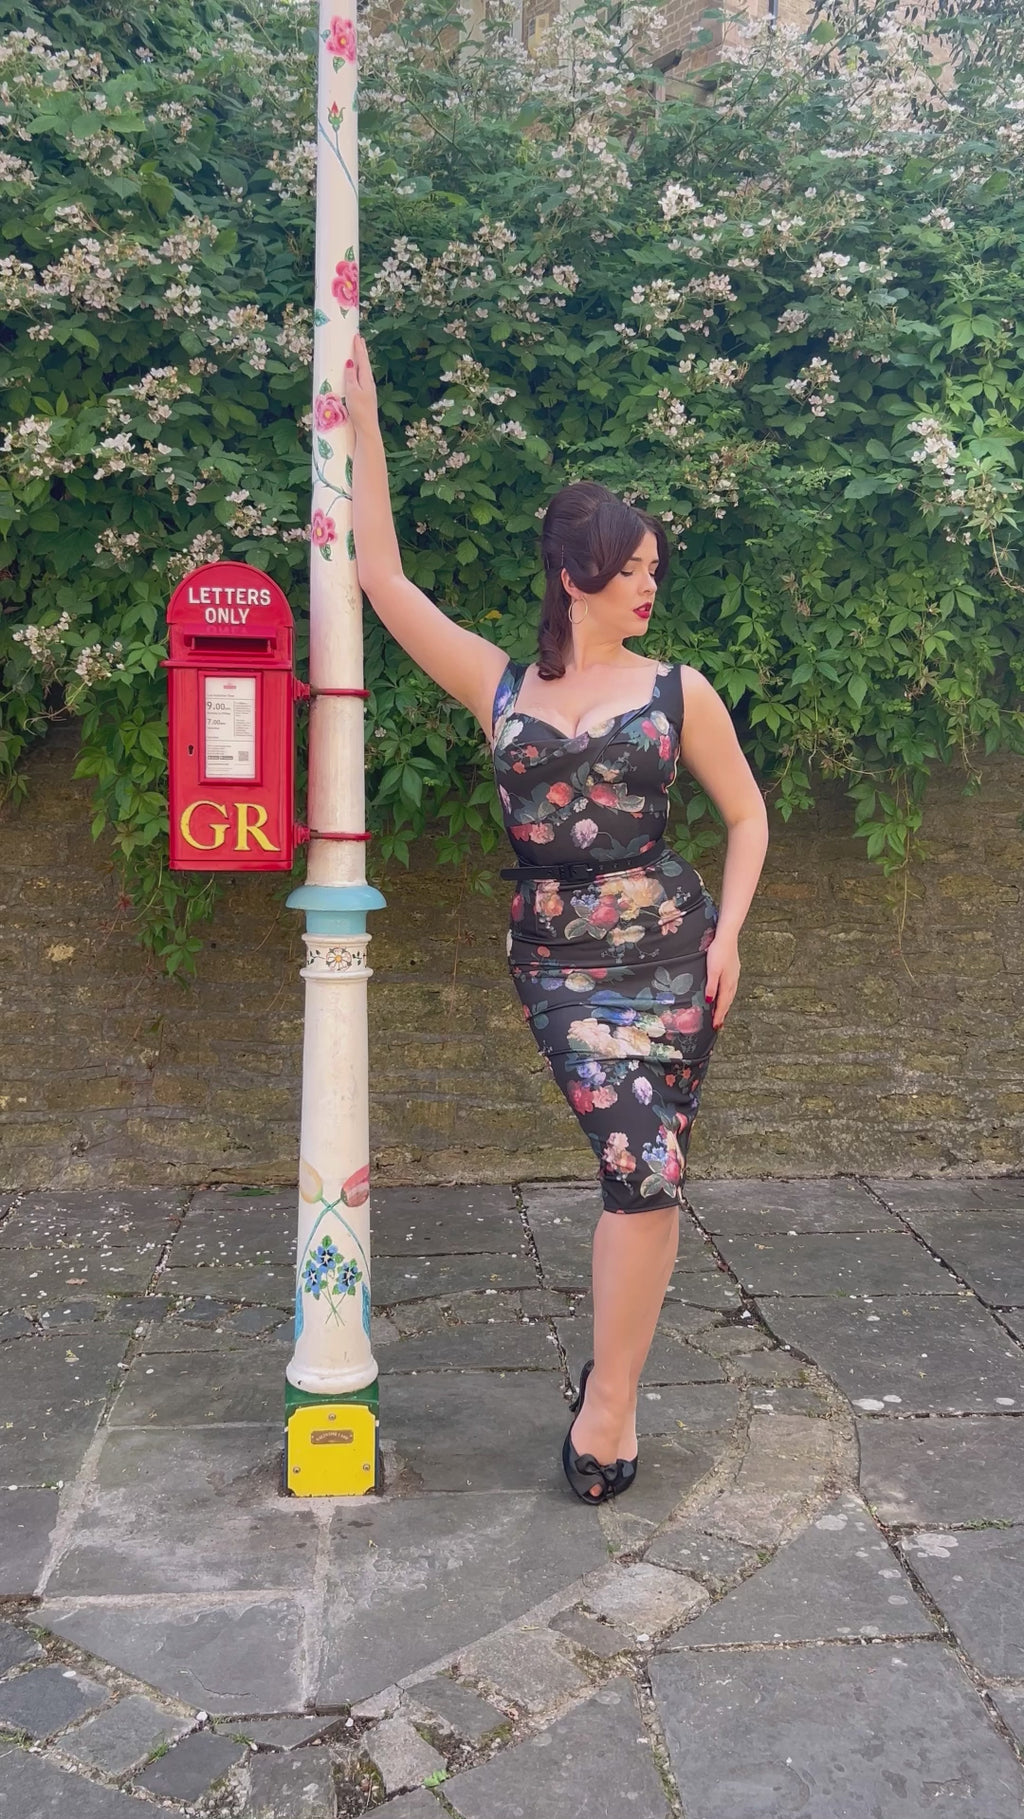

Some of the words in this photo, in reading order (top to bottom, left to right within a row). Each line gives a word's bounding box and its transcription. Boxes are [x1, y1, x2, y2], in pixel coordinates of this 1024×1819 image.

[188, 587, 271, 606] LETTERS
[204, 607, 250, 625] ONLY
[180, 800, 281, 852] GR
